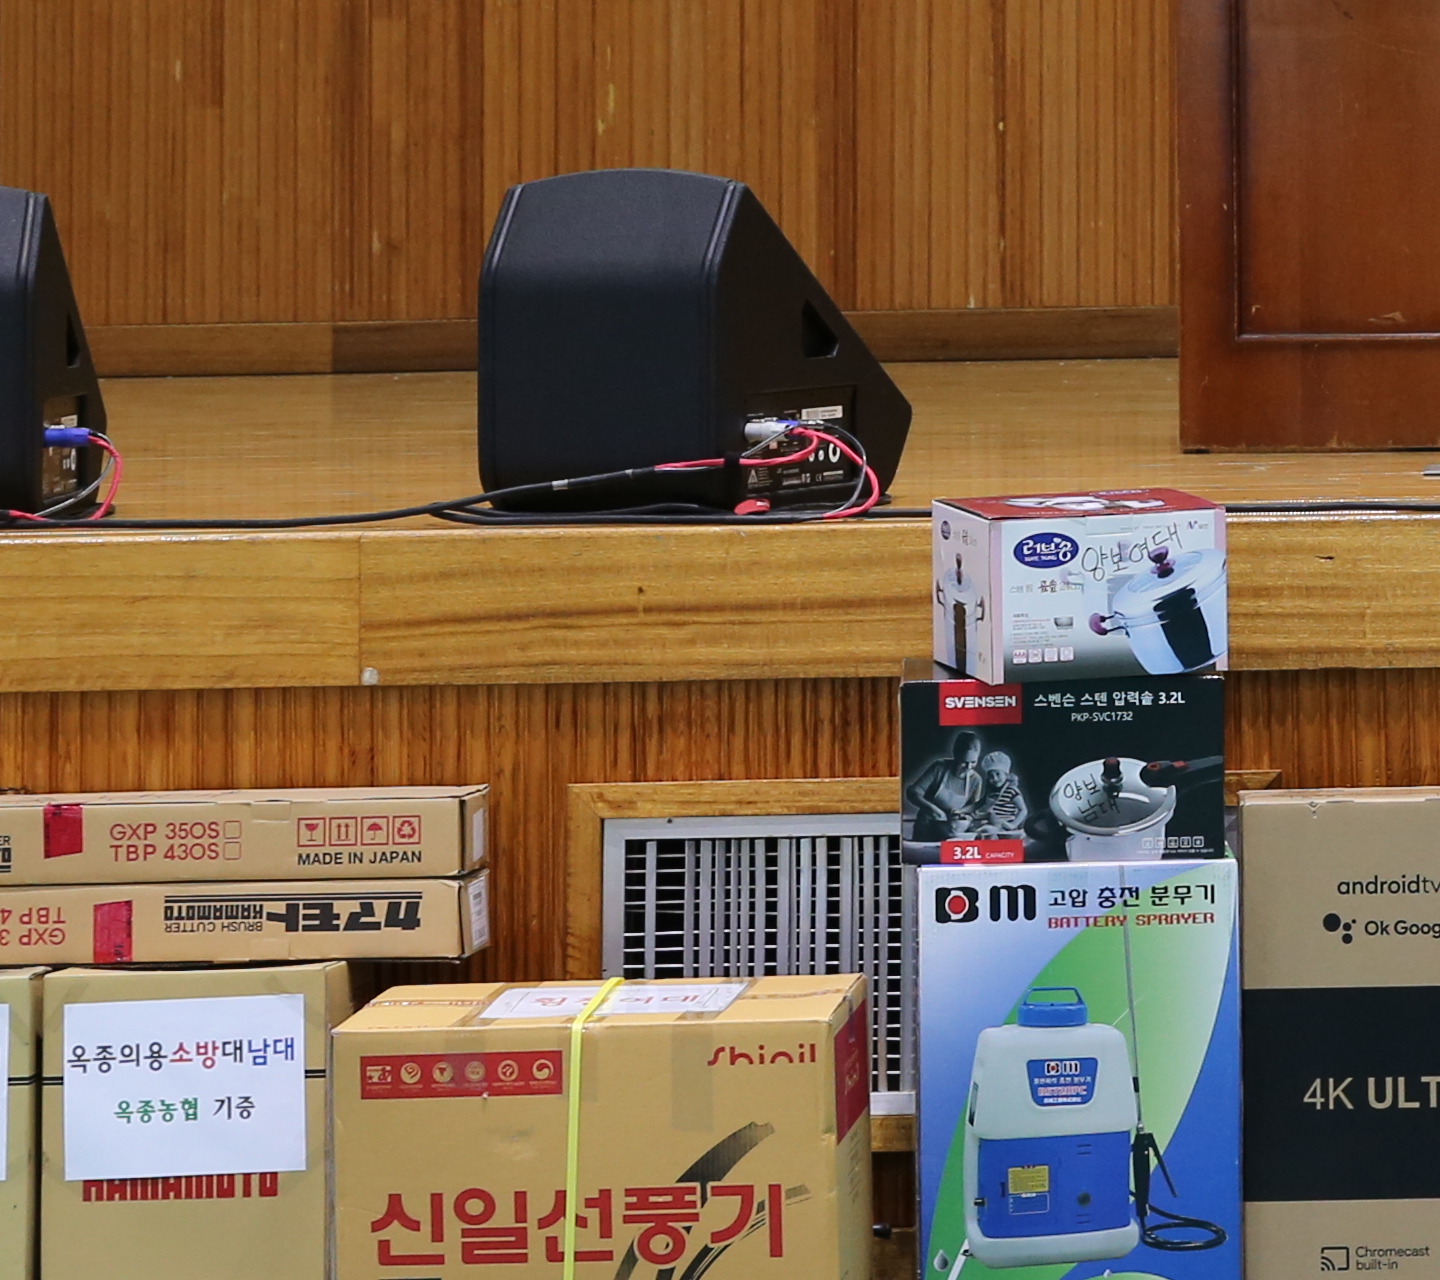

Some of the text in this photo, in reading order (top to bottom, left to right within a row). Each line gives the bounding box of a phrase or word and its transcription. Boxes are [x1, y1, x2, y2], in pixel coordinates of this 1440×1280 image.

[945, 694, 1017, 711] SVENSEN
[1034, 690, 1186, 708] 스벤슨 스텐 압력솥 3.2L
[1070, 710, 1134, 723] PKP-SVC1732
[108, 822, 159, 842] GXP
[109, 843, 158, 863] TBP
[296, 850, 423, 867] MADE IN JAPAN
[952, 845, 982, 860] 3.2L
[1048, 884, 1217, 909] 고압 충전 분무기
[18, 907, 67, 925] TBP
[1047, 911, 1216, 930] BATTERY SPRAYER
[163, 921, 264, 934] BRUSH CUTTER
[1364, 918, 1391, 937] Ok
[17, 928, 67, 946] GXP
[66, 1037, 296, 1073] 옥종의용소방대남대
[1302, 1077, 1355, 1111] 4K
[113, 1095, 256, 1124] 옥종농협 기증
[370, 1182, 784, 1267] 신일선풍기
[1355, 1244, 1431, 1260] Chromecast
[1355, 1258, 1399, 1272] built-in
